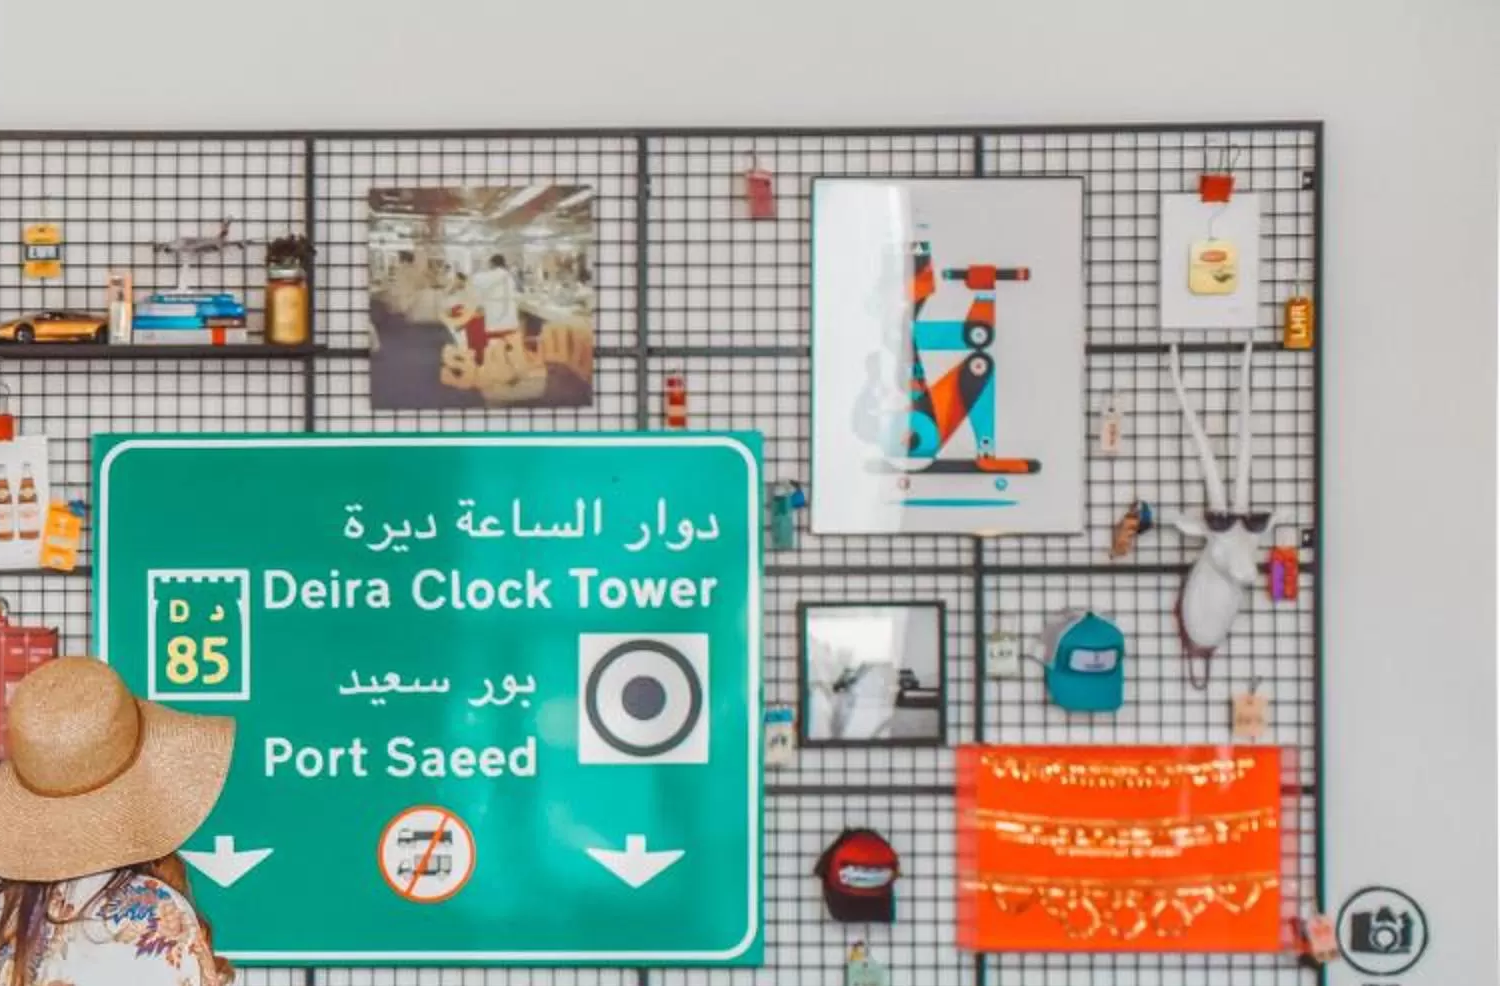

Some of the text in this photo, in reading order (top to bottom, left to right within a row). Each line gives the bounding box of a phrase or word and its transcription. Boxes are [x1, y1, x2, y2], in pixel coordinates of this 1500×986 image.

[343, 499, 719, 551] دوار الساعة ديرة
[265, 567, 717, 610] Deira Clock Tower
[169, 599, 189, 623] D
[166, 635, 229, 684] 85
[339, 669, 535, 707] بور سعيد
[265, 736, 536, 777] Port Saeed
